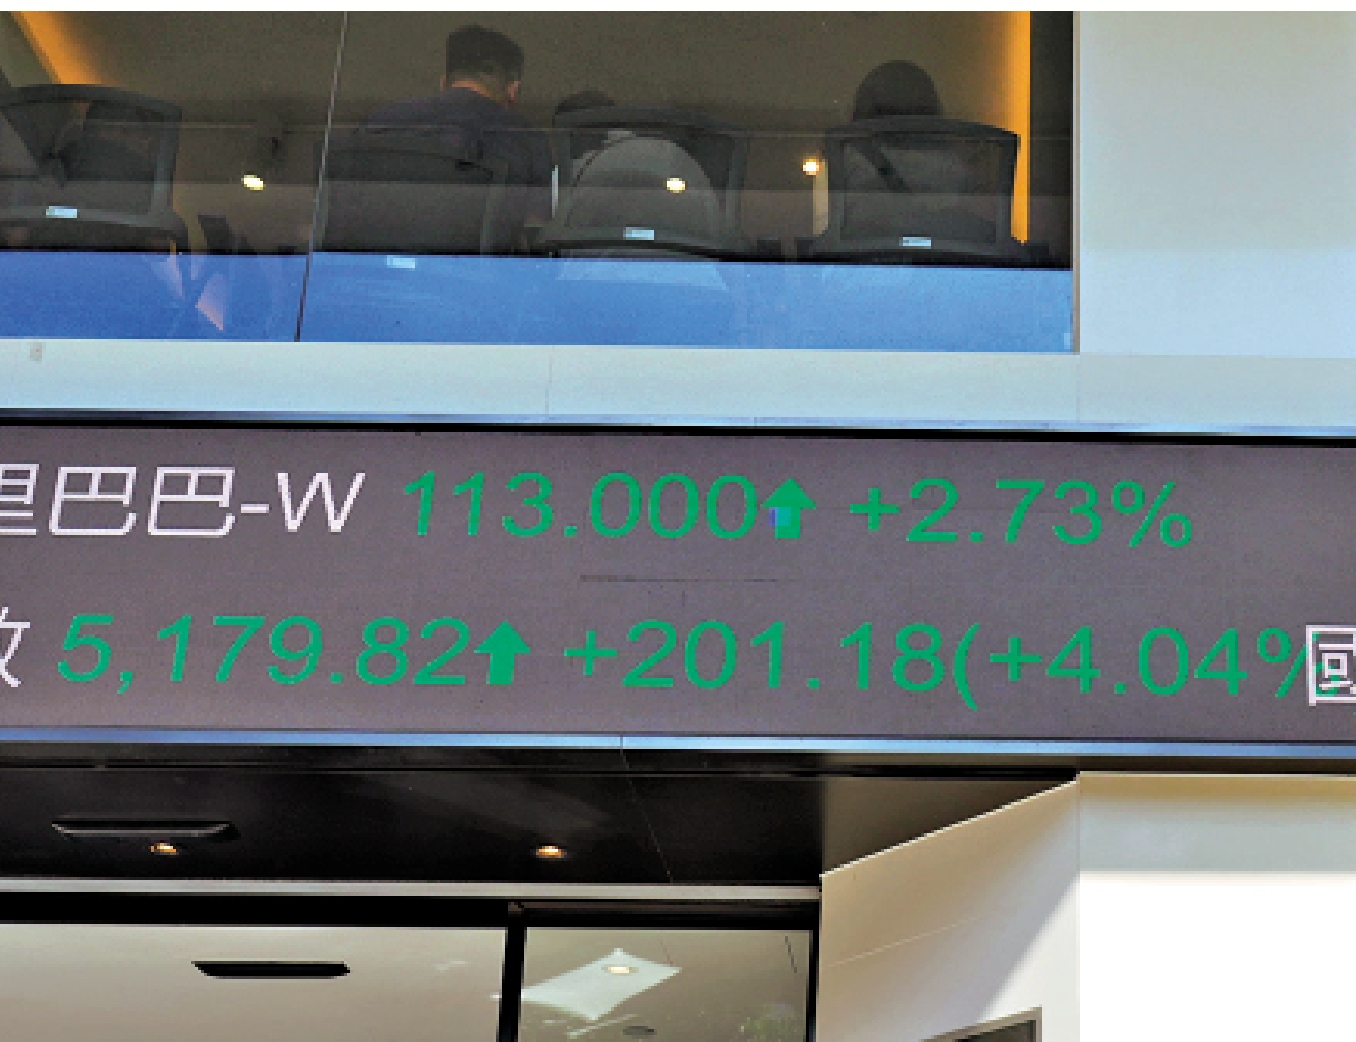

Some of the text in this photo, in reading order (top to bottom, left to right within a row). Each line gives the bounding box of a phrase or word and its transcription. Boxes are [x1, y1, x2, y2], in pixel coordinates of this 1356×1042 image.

[405, 471, 758, 539] 113.000
[849, 477, 1193, 548] +2.73%
[57, 614, 471, 694] 5,179.82
